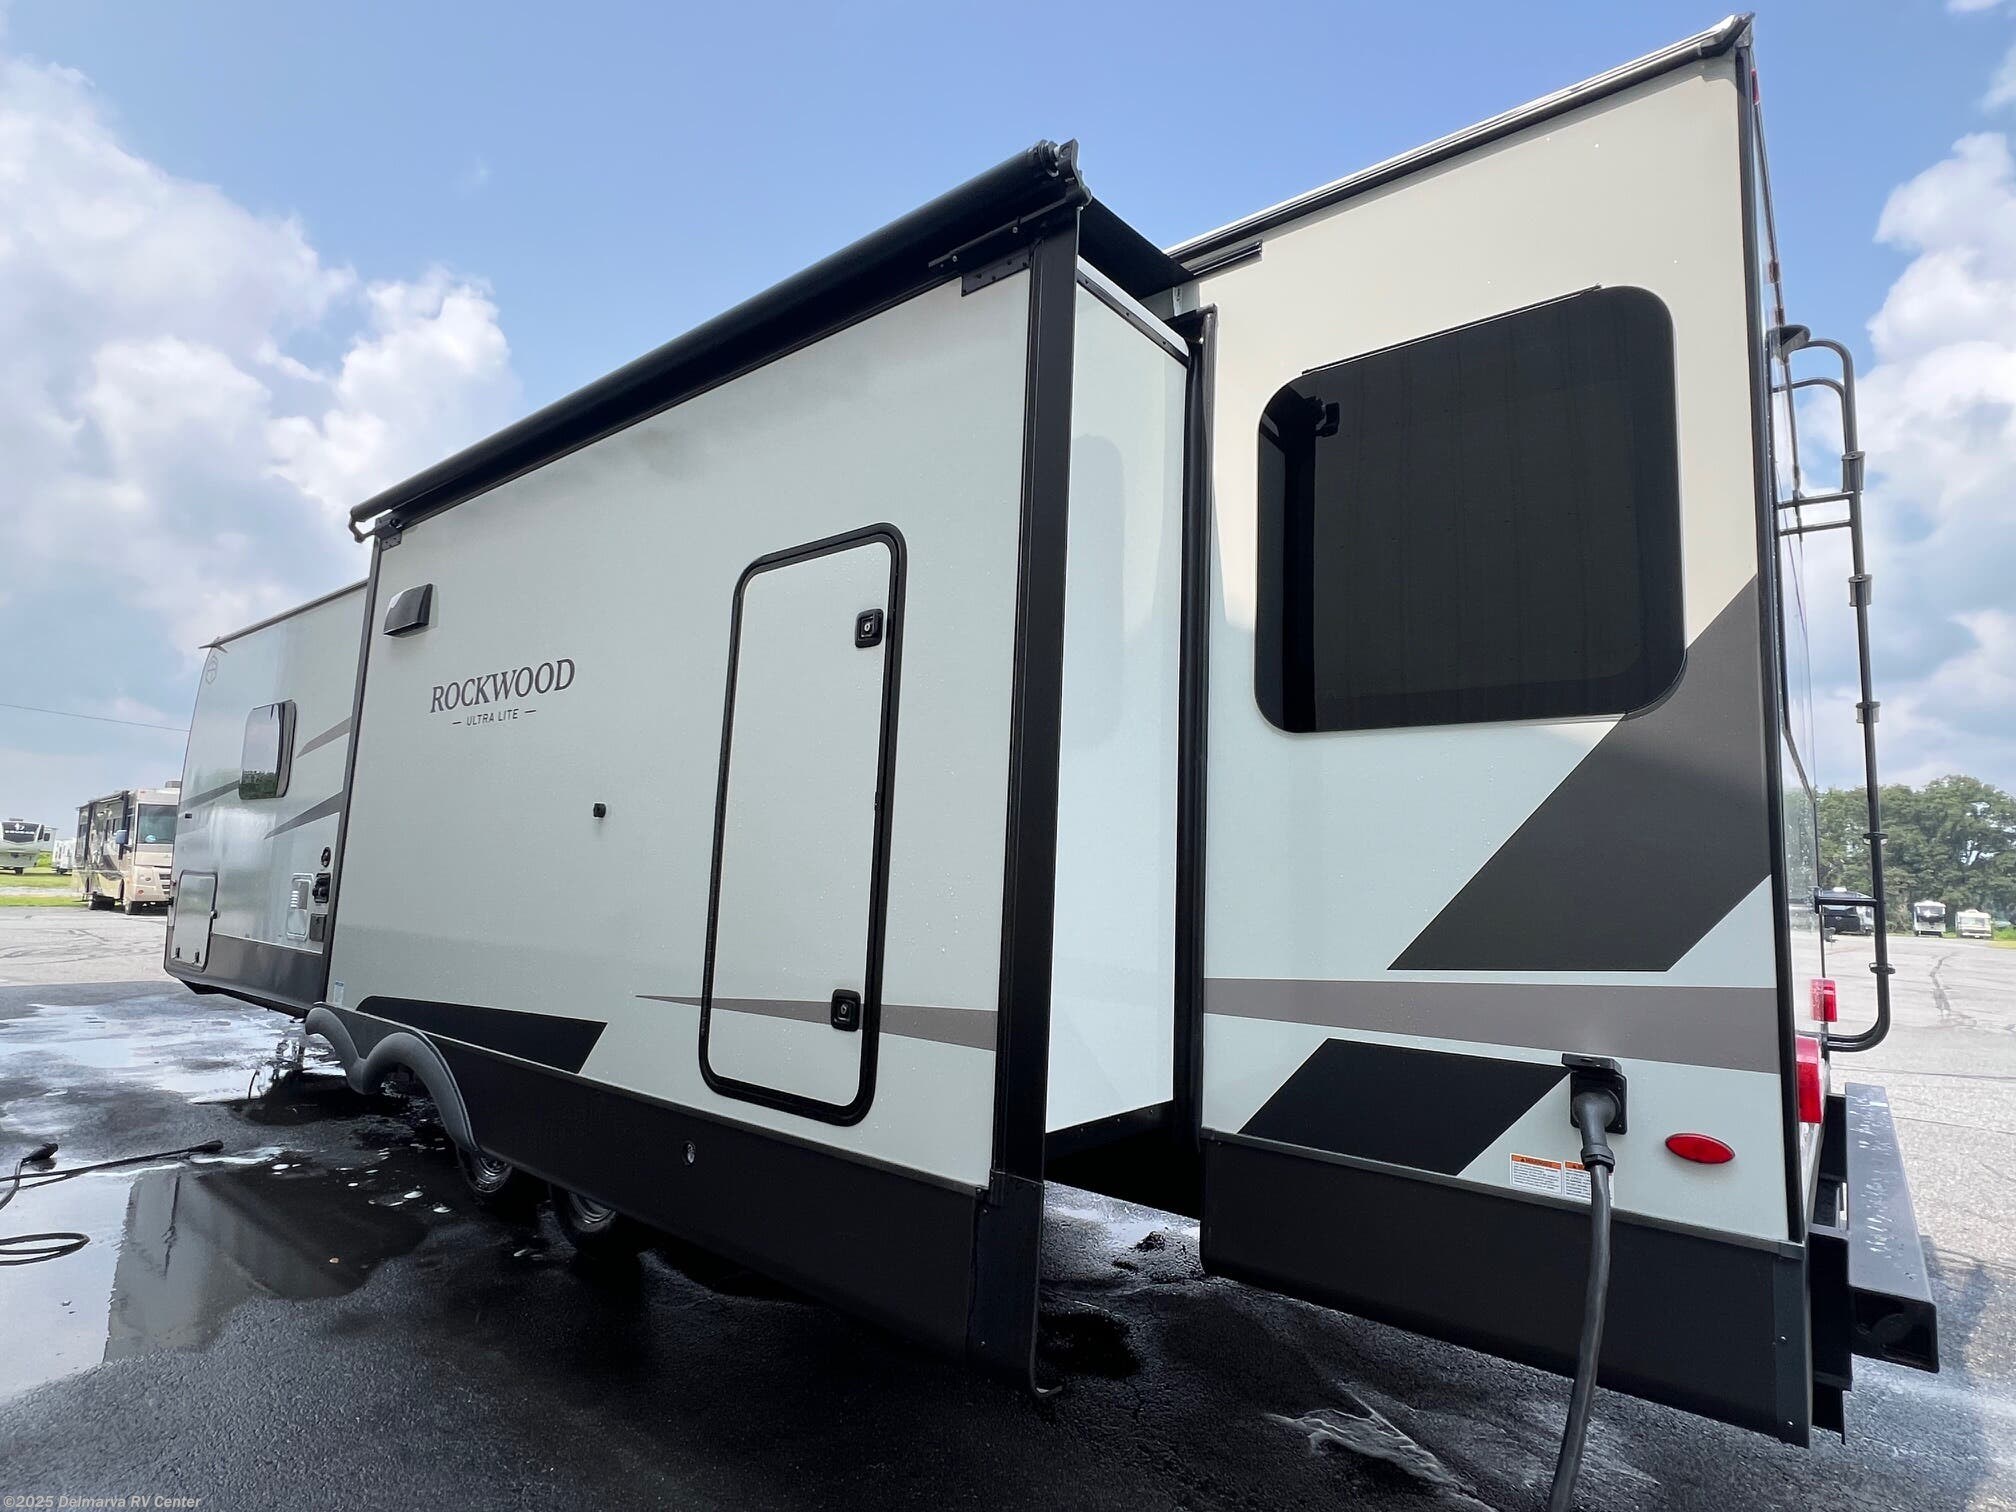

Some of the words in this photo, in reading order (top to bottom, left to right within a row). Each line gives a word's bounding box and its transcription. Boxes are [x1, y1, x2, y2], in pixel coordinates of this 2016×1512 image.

[430, 658, 576, 713] ROCKWOOD
[466, 713, 495, 726] ULTRA
[498, 708, 519, 721] LITE
